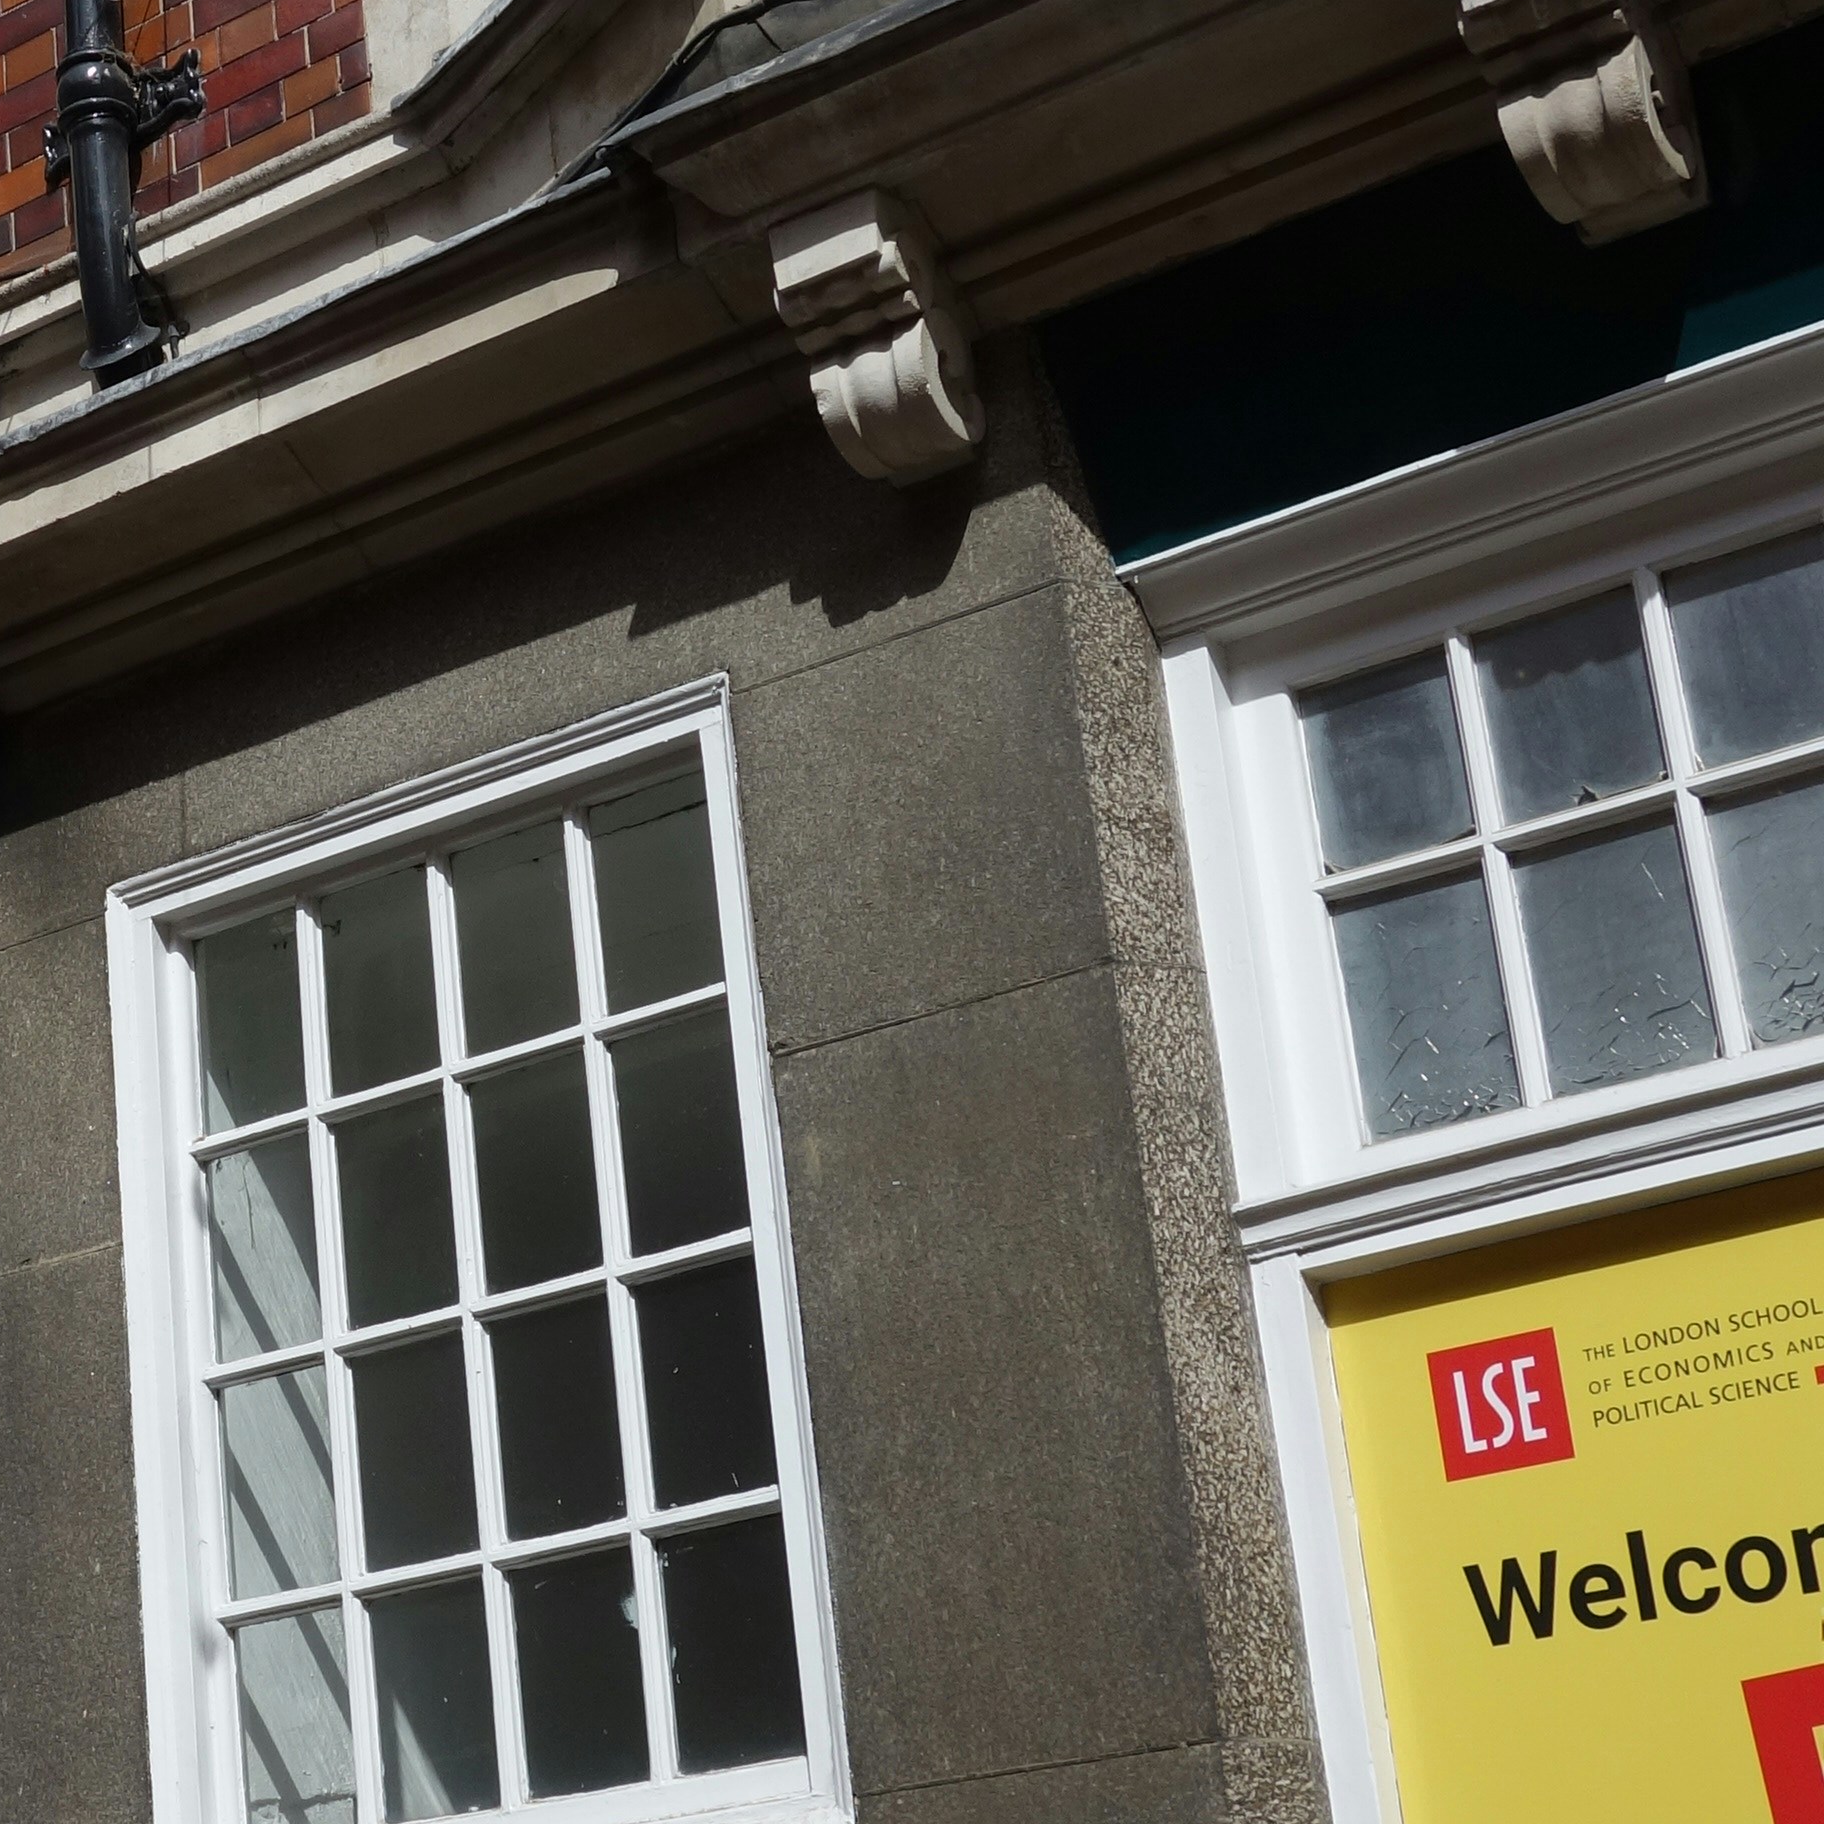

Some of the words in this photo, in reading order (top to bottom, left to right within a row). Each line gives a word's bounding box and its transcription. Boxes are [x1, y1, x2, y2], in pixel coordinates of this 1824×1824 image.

[1582, 1343, 1616, 1362] THE
[1622, 1317, 1721, 1355] LONDON
[1728, 1297, 1824, 1333] SCHOOL
[1588, 1377, 1613, 1396] OF
[1623, 1341, 1775, 1389] ECONOMICS
[1592, 1390, 1703, 1428] POLITICAL
[1709, 1370, 1801, 1406] SCIENCE
[1452, 1355, 1548, 1454] LSE
